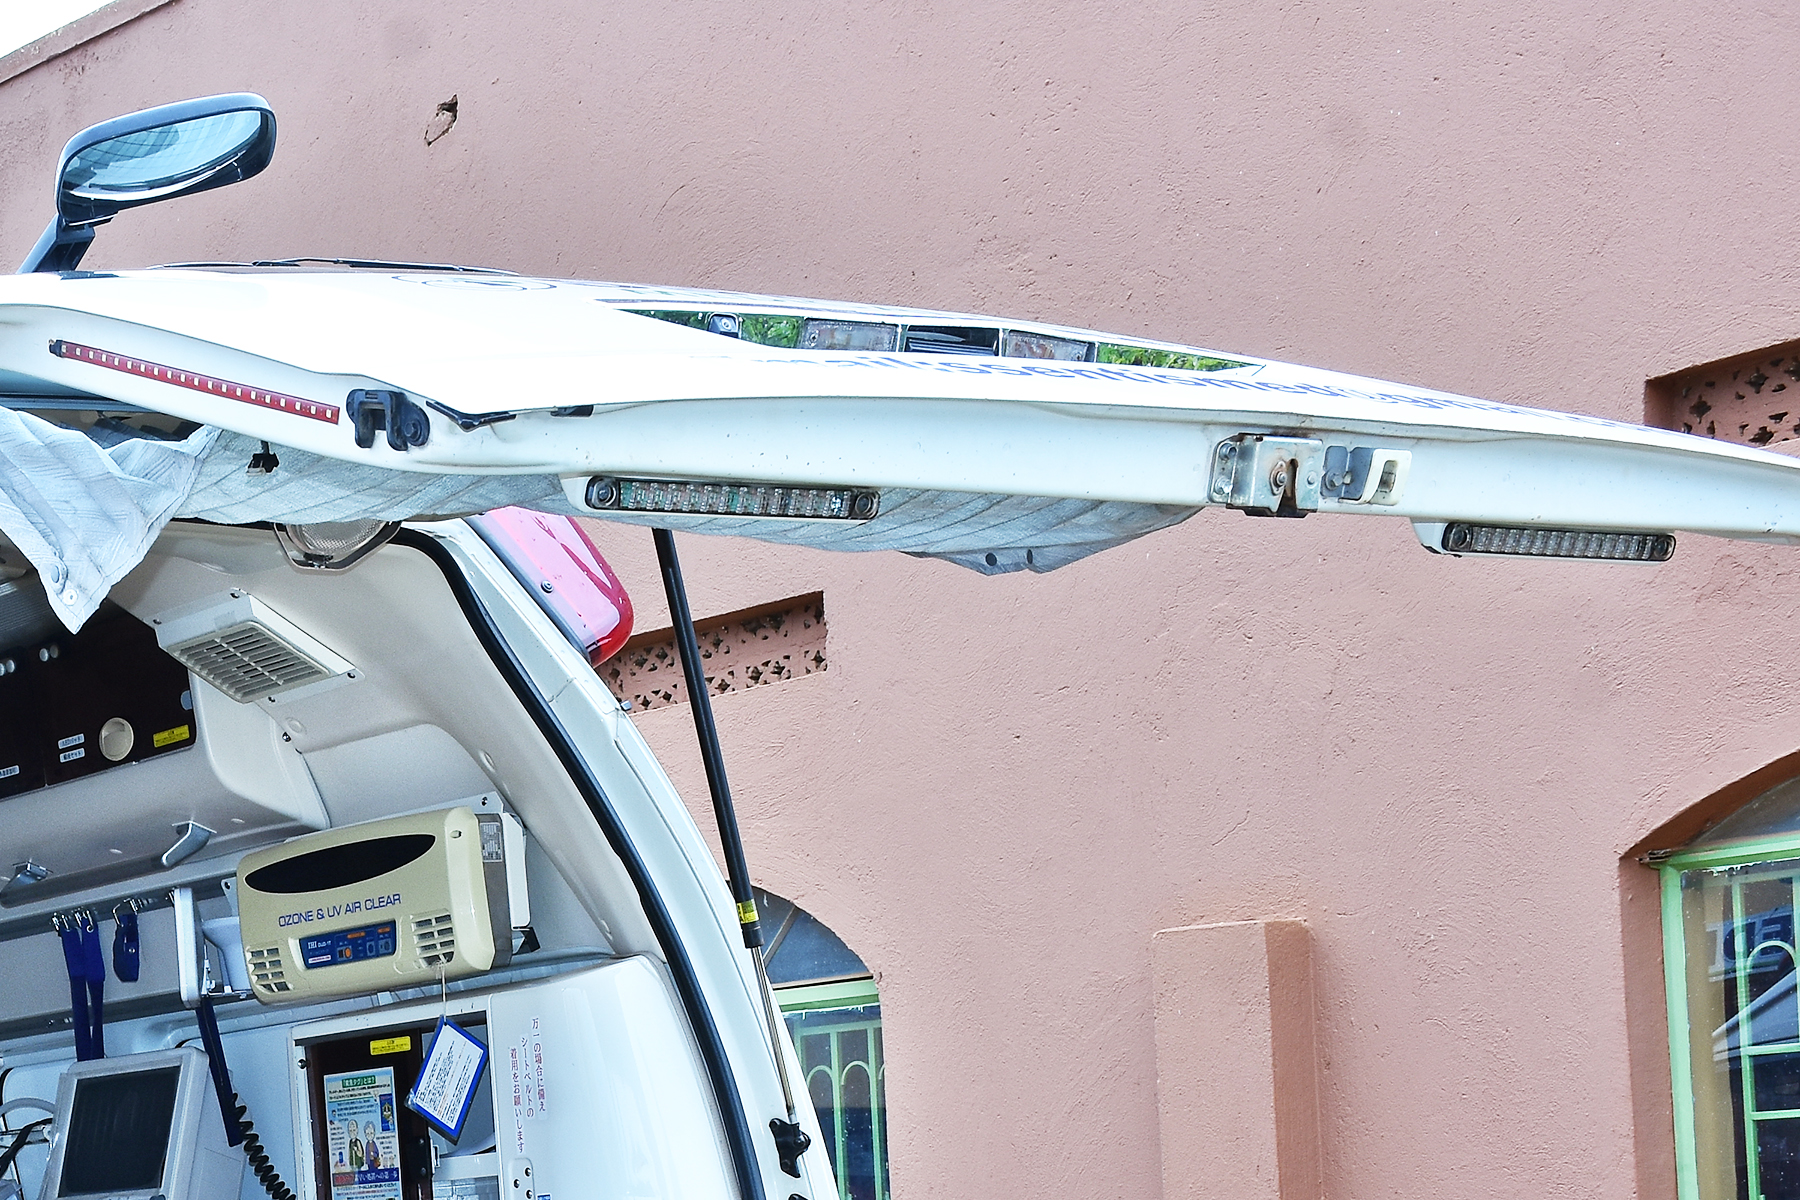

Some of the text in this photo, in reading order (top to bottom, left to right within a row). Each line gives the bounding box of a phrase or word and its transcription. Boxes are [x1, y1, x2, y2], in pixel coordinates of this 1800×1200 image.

[279, 893, 401, 928] OZONE & UV AIR CLEAR
